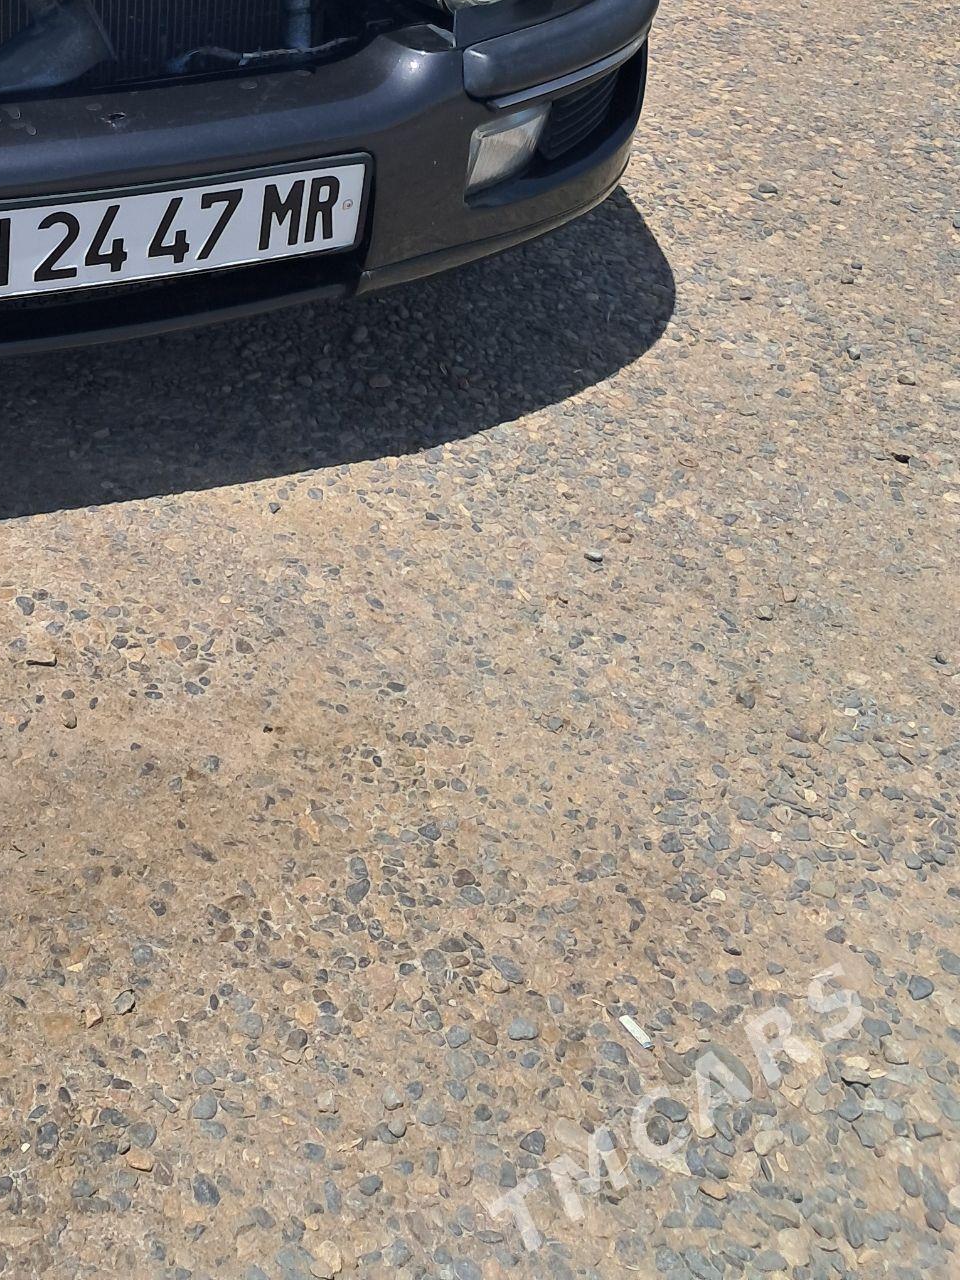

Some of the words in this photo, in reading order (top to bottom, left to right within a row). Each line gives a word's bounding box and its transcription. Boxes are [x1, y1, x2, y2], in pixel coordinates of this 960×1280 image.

[34, 205, 128, 283] 24
[148, 189, 244, 264] 47
[258, 176, 340, 251] MR
